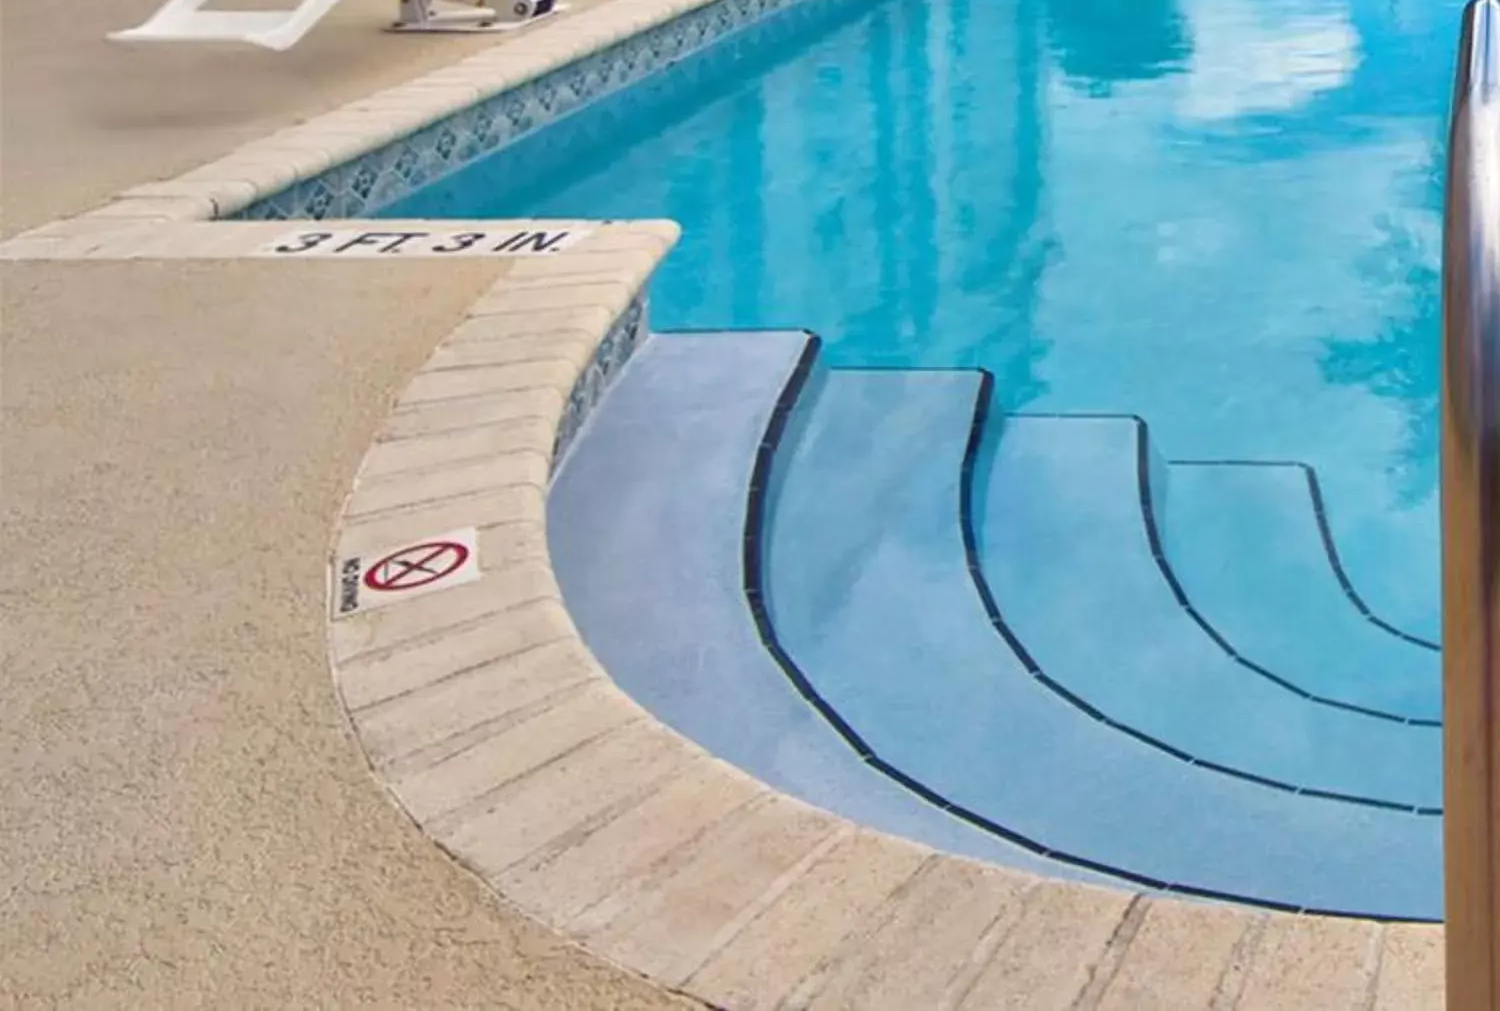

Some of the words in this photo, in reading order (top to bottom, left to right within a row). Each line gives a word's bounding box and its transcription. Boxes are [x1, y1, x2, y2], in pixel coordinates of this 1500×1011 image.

[275, 232, 332, 252] 3
[334, 232, 429, 253] FT.
[431, 232, 485, 252] 3
[492, 231, 568, 252] IN.
